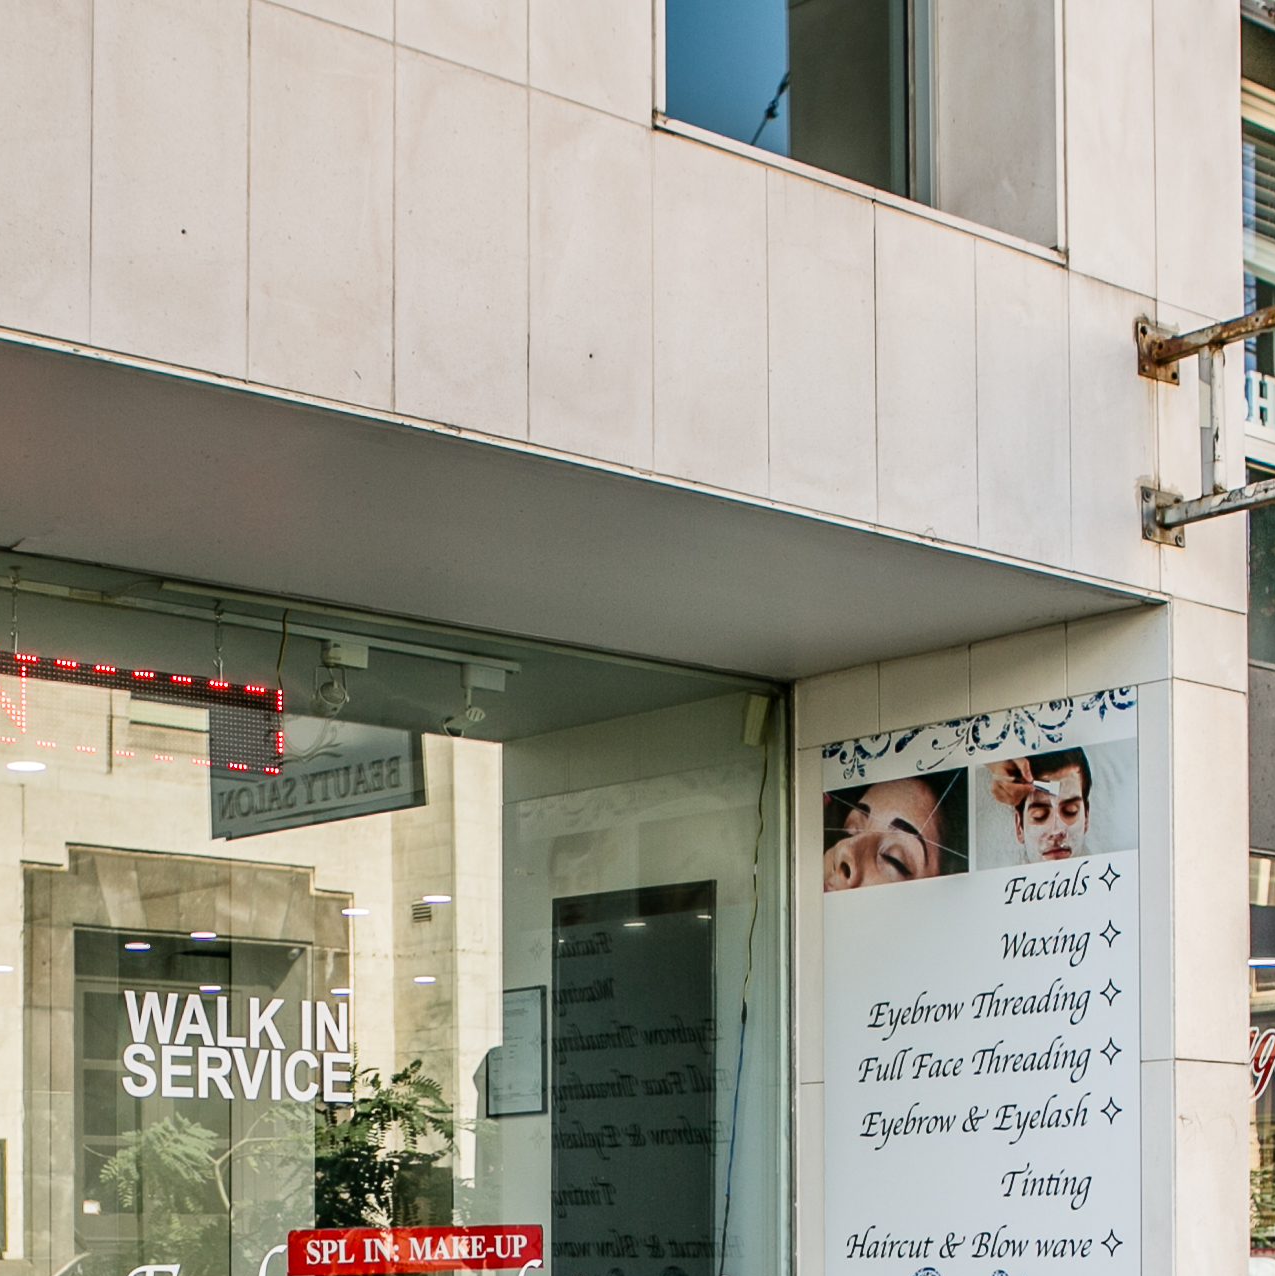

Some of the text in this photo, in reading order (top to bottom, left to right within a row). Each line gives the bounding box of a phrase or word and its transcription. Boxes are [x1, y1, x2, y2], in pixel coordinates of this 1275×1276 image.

[1004, 860, 1090, 905] Facials
[1001, 926, 1090, 967] Waxing
[124, 990, 348, 1052] WALK IN
[867, 977, 1091, 1040] Eyebrow Threading
[122, 1042, 353, 1104] SERVICE
[858, 1035, 1091, 1085] Full Face Threading
[859, 1092, 1089, 1150] Eyebrow & Eyelash
[1001, 1161, 1092, 1210] Tinting
[305, 1234, 528, 1264] SPL IN: MAKE-UP
[846, 1221, 1092, 1259] Haircut & Blow wave
